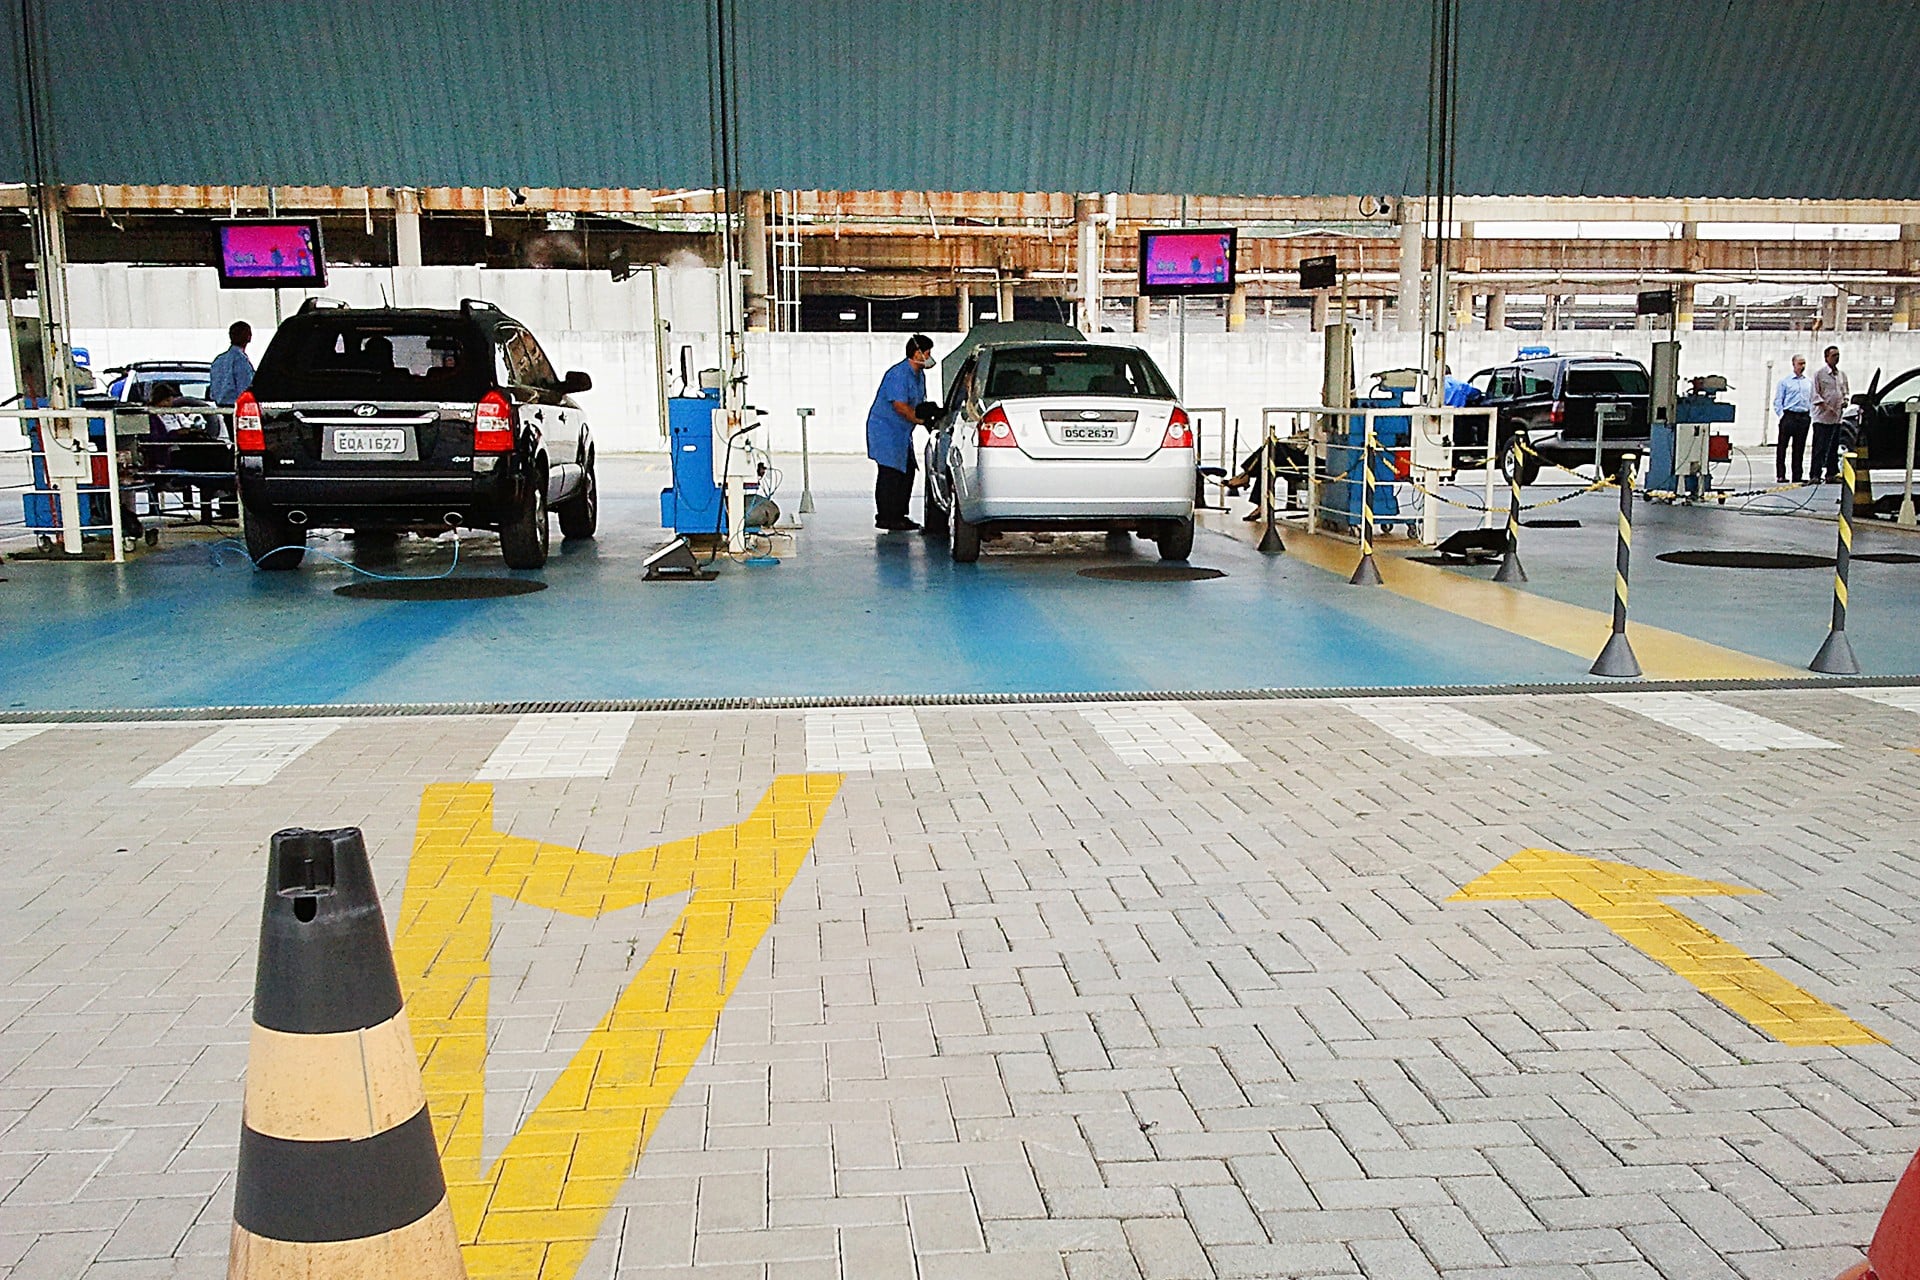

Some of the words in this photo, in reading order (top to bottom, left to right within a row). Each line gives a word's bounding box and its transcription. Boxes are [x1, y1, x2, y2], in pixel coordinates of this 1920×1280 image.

[1065, 429, 1086, 438] DSC
[1087, 429, 1114, 438] 2637
[339, 438, 364, 451] EQA
[369, 438, 400, 451] 1627
